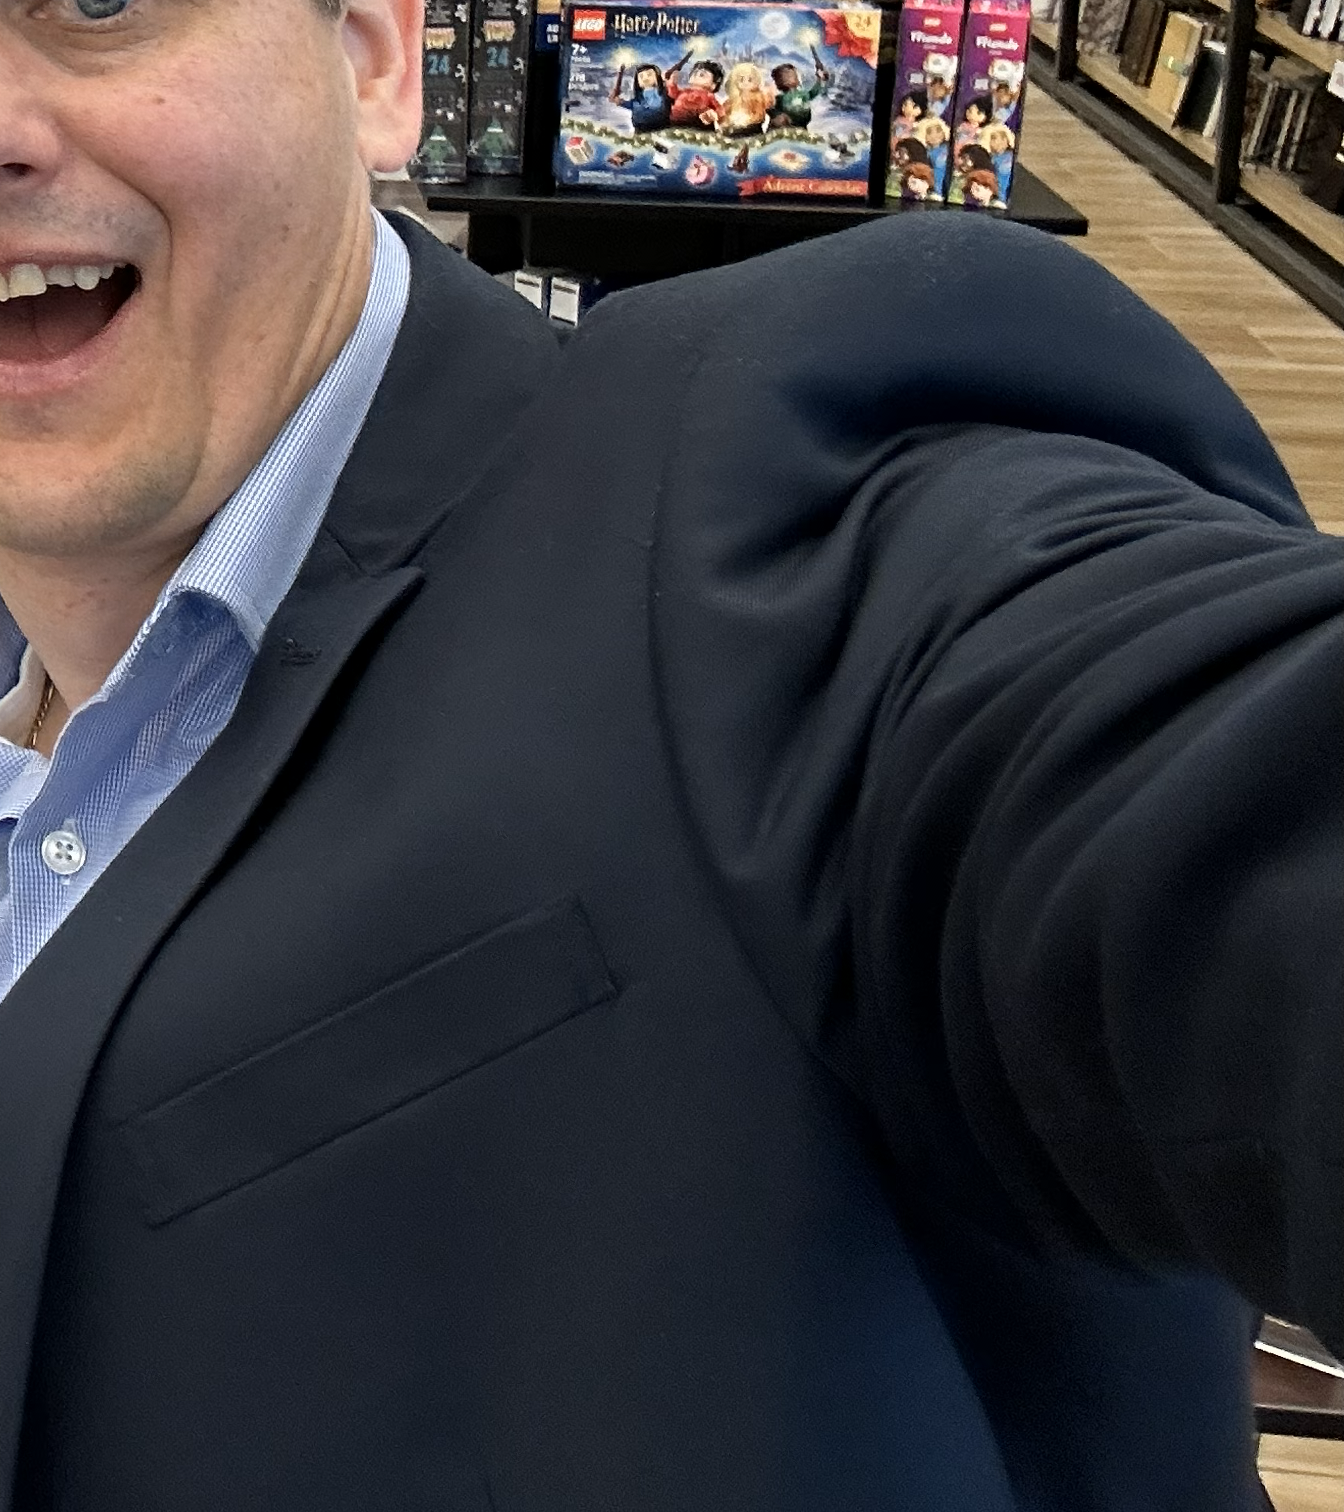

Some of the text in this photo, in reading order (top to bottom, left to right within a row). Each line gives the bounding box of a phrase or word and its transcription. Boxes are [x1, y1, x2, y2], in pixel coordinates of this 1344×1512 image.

[572, 17, 605, 32] LEGO
[614, 12, 701, 36] Harry Potter
[910, 31, 952, 45] Friends
[976, 35, 1019, 51] Friends
